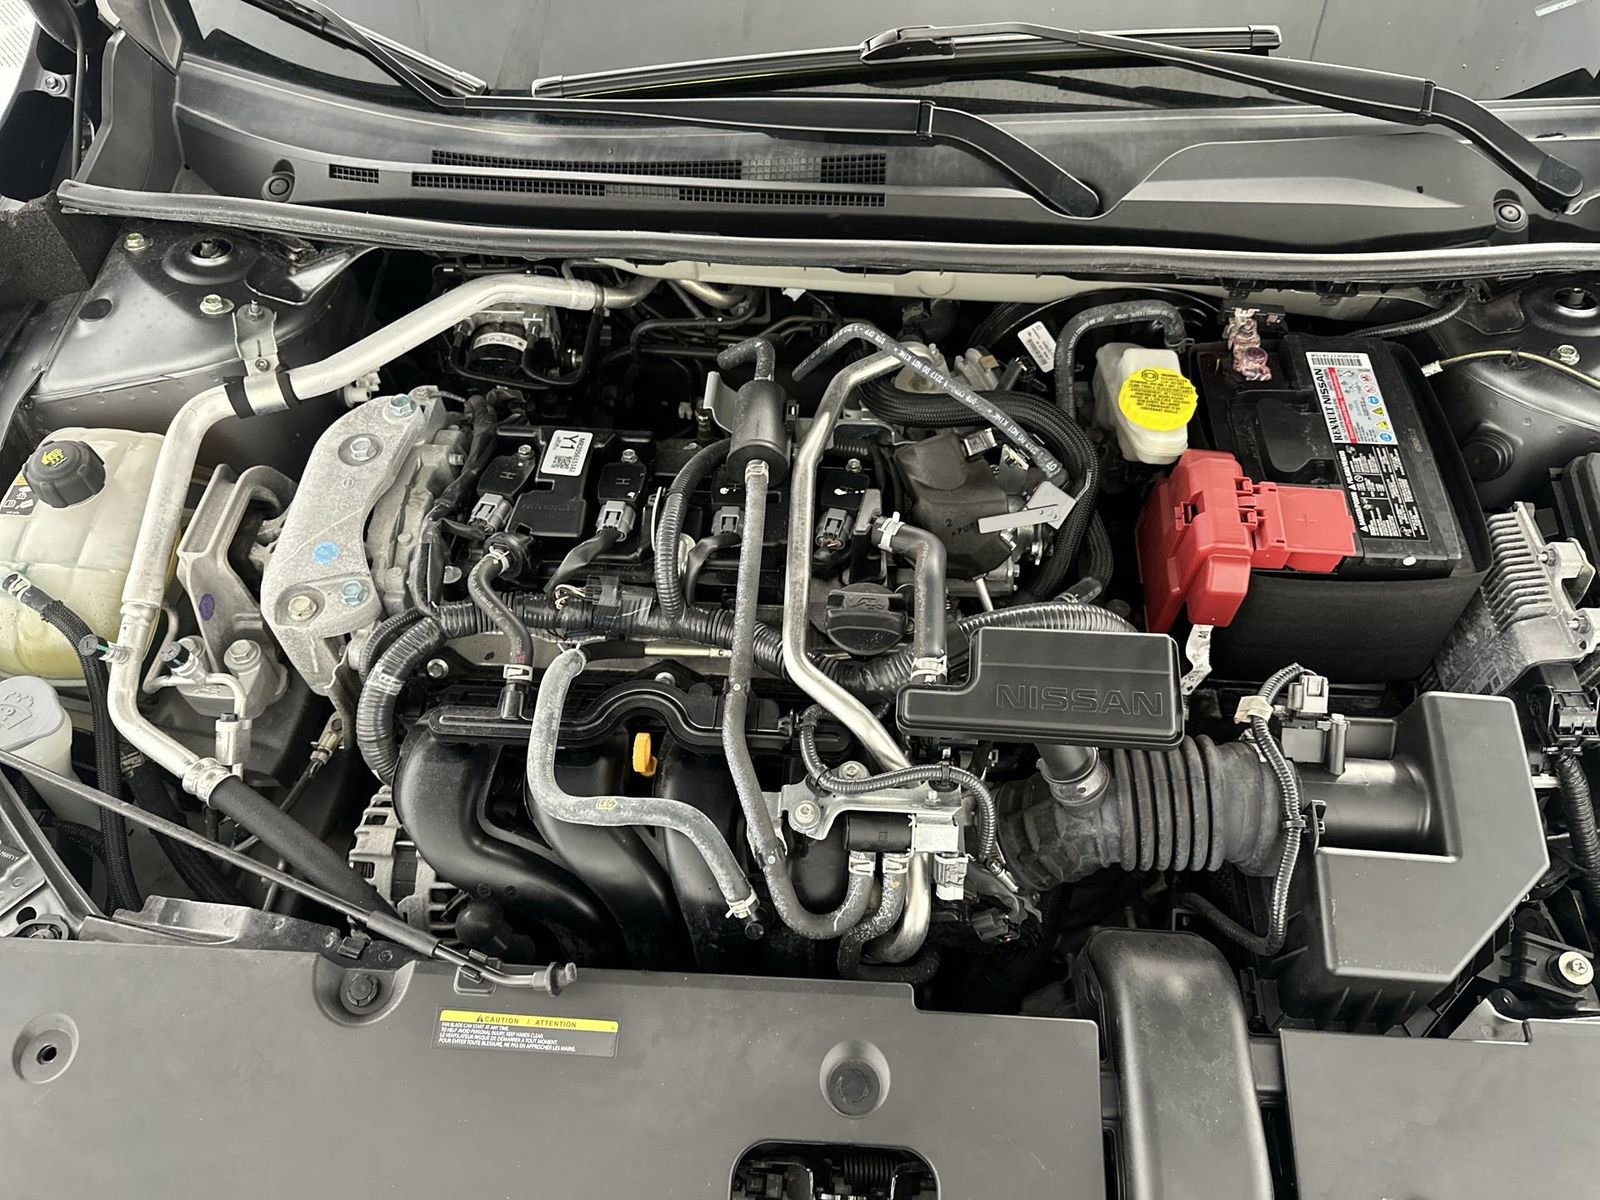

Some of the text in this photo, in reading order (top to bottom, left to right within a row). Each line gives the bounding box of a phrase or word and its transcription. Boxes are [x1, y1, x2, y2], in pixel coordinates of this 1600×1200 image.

[1314, 368, 1342, 441] RENAULT NISSAN
[560, 434, 579, 449] Y1
[996, 684, 1163, 717] NISSAN
[536, 1020, 576, 1028] ATTENTION
